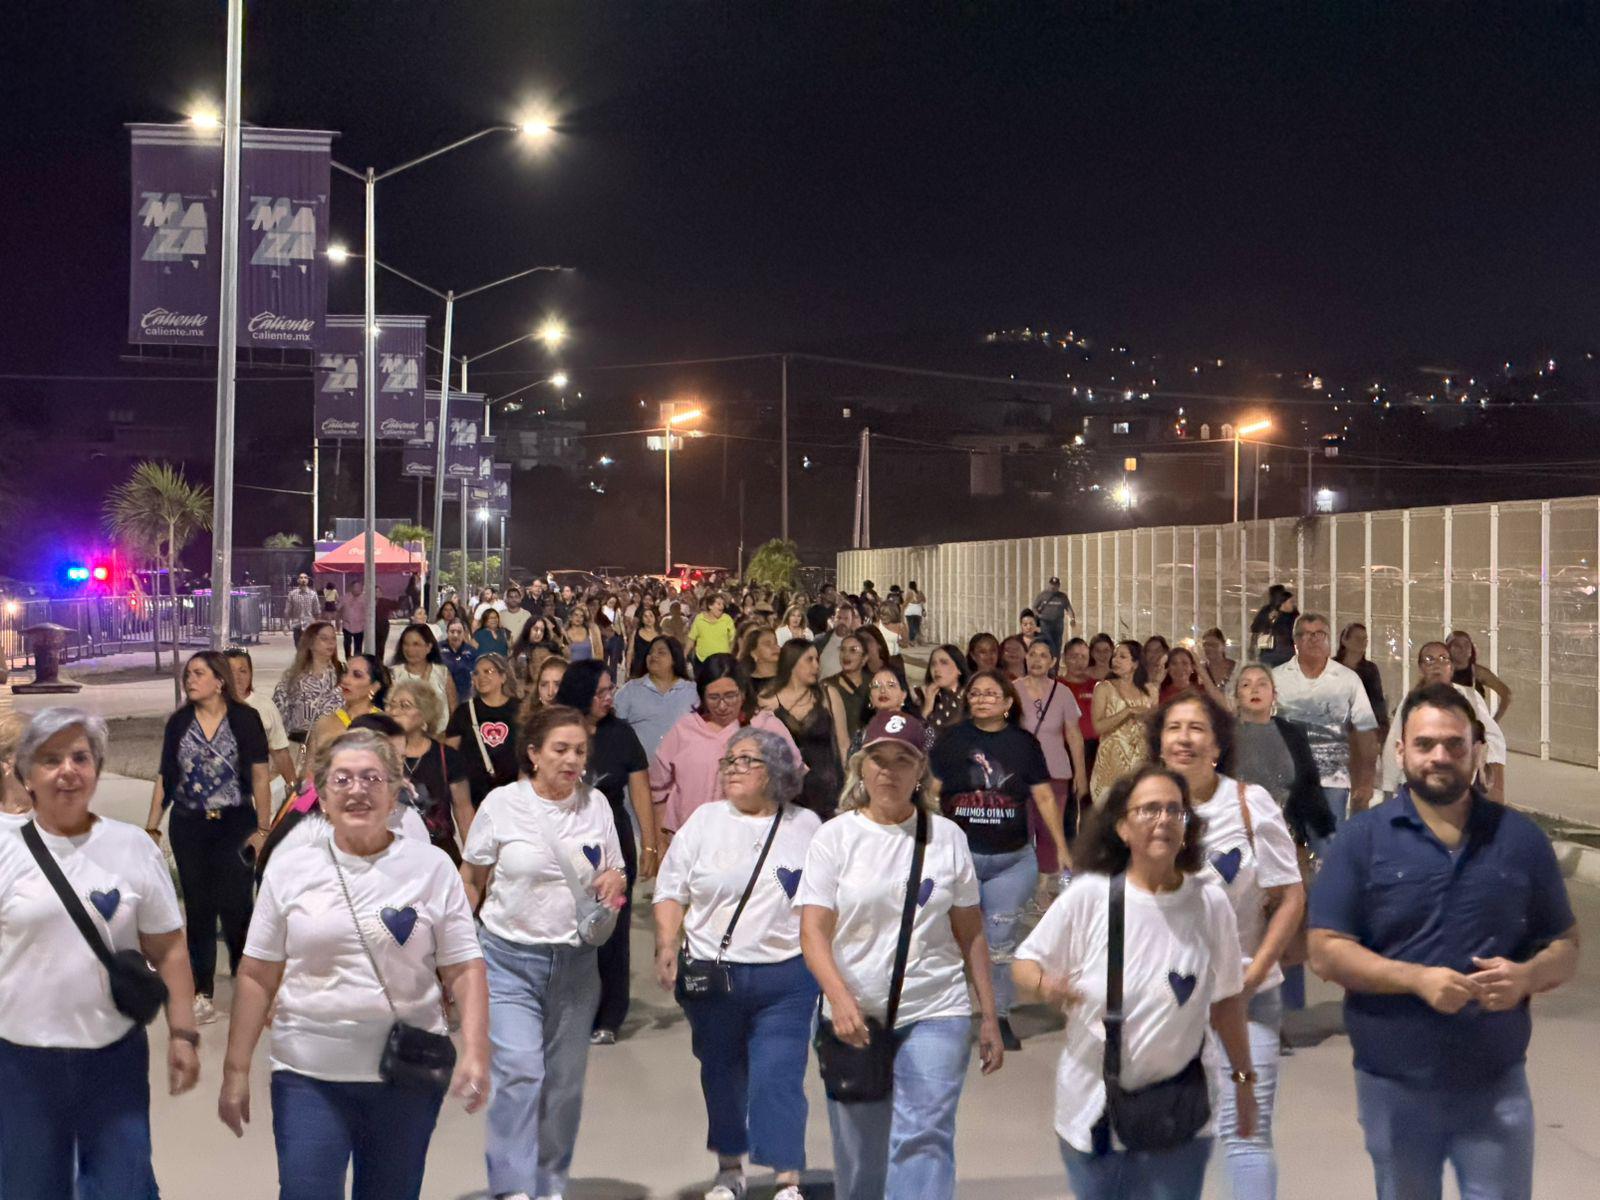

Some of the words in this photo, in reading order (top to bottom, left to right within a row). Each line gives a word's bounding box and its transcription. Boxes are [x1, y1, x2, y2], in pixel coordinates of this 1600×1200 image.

[141, 308, 208, 328] Caliente
[248, 311, 315, 331] Caliente
[145, 328, 205, 337] caliente.mx
[252, 331, 311, 341] caliente.mx
